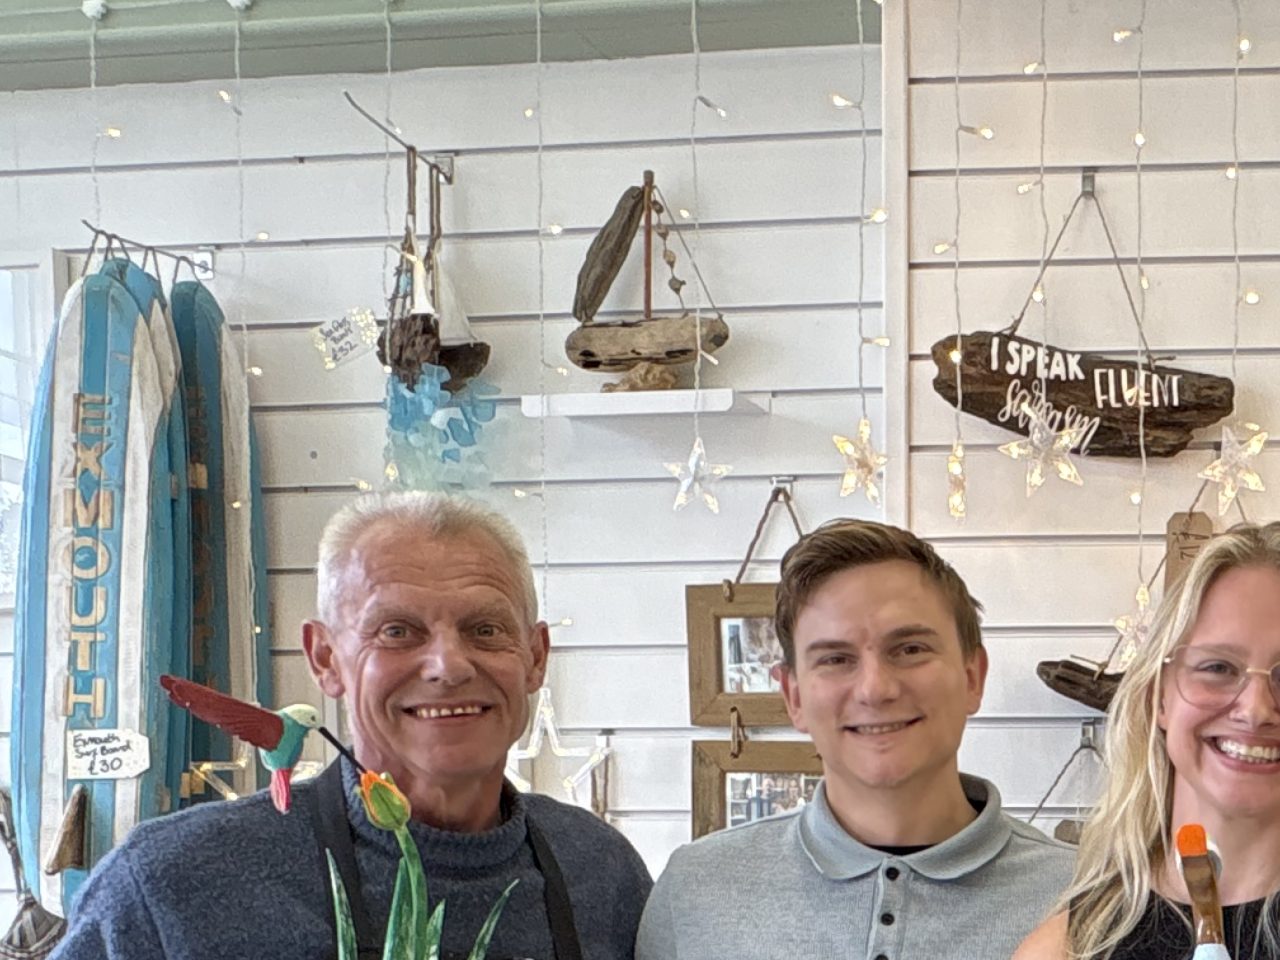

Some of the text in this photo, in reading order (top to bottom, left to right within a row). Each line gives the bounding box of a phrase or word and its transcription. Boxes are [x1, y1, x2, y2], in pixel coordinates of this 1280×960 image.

[990, 336, 1183, 409] I SPEAK FLUENT
[63, 392, 114, 720] EXMOUTH
[87, 757, 123, 775] £30
